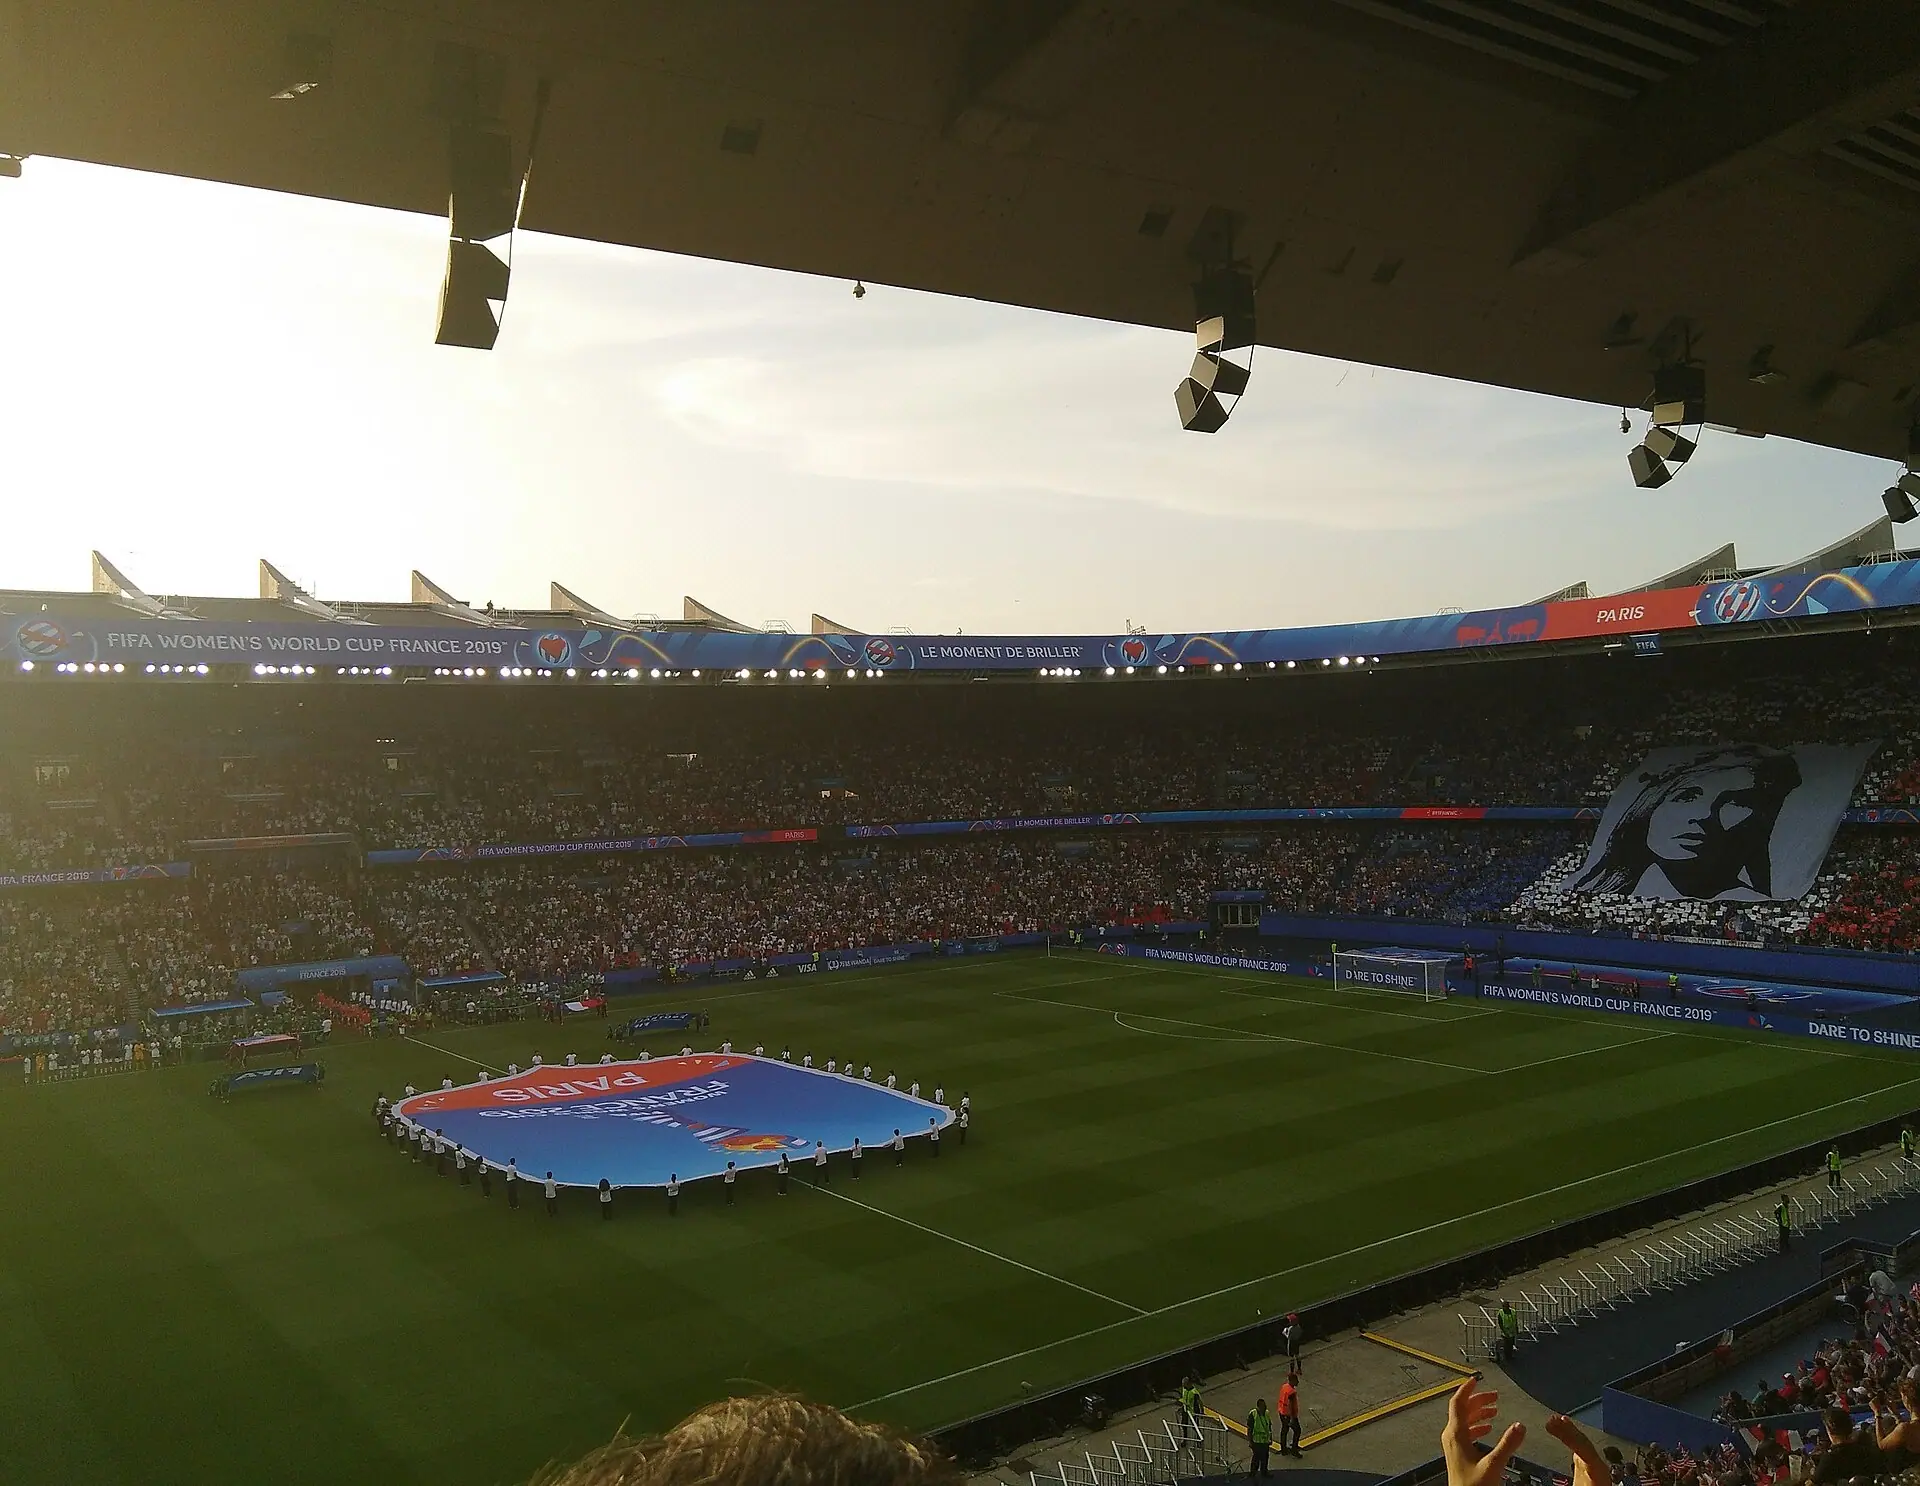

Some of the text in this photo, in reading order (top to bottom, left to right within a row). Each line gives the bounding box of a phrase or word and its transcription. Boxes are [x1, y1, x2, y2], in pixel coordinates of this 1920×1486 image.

[1597, 606, 1644, 623] PARIS
[107, 633, 152, 648] FIFA
[158, 634, 263, 651] WOMEN'S
[267, 636, 341, 651] WORLD
[346, 638, 384, 652] CUP
[389, 639, 461, 654] FRANCE
[1636, 641, 1656, 649] FIFA
[920, 646, 938, 658] LE
[941, 646, 1002, 659] MOMENT
[1007, 647, 1024, 658] DE
[1024, 818, 1053, 826] MOMENT
[478, 848, 495, 856] FIFA
[496, 845, 535, 855] WOMEN'S
[536, 844, 566, 853] WORLD
[567, 843, 583, 851] CUP
[584, 841, 614, 850] FRANCE
[22, 873, 64, 884] FRANCE
[1145, 948, 1159, 958] FIFA
[1161, 950, 1194, 962] WOMEN'S
[1194, 953, 1221, 965] WORLD
[1222, 956, 1238, 967] CUP
[1239, 958, 1268, 970] FRANCE
[798, 963, 817, 973] VISA
[1345, 970, 1369, 981] DARE
[1371, 972, 1383, 982] TO
[1484, 985, 1505, 997] FIFA
[1507, 987, 1559, 1003] WOMEN'S
[1561, 994, 1602, 1008] WORLD
[1606, 999, 1631, 1012] CUP
[1633, 1002, 1682, 1018] FRANCE
[1809, 1022, 1920, 1048] DARE TO SHINE
[493, 1071, 648, 1101] PARIS
[570, 1080, 730, 1114] FRANCE
